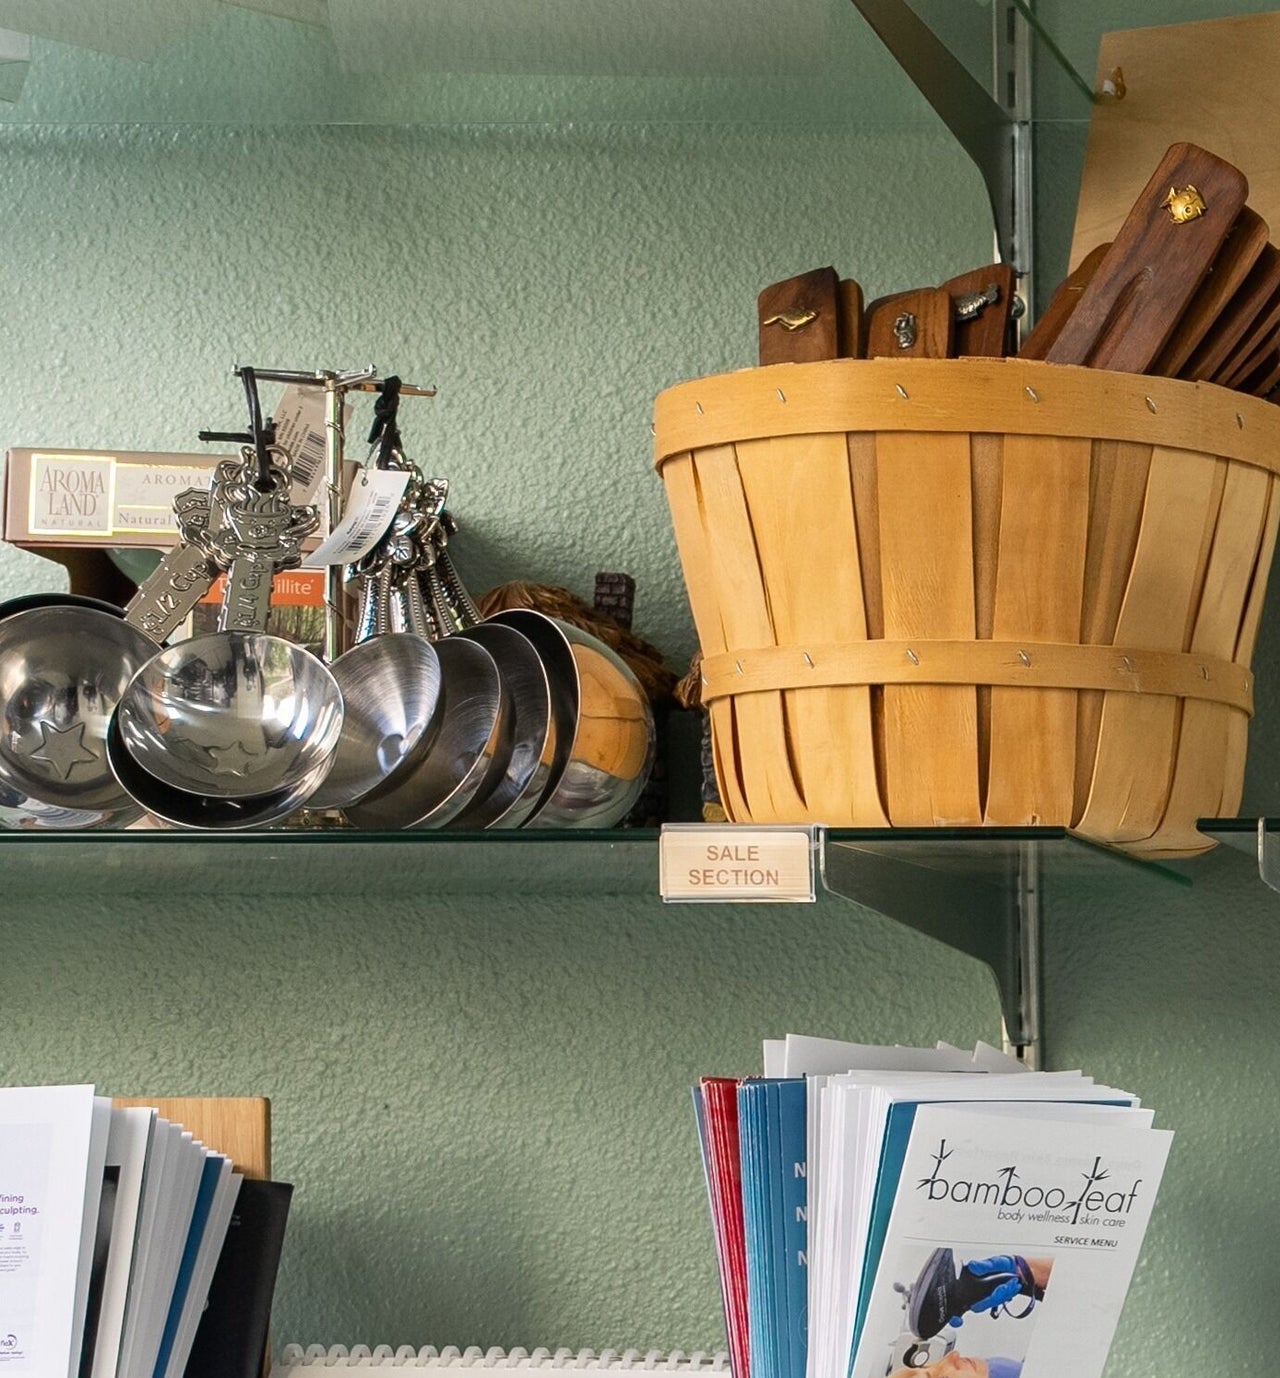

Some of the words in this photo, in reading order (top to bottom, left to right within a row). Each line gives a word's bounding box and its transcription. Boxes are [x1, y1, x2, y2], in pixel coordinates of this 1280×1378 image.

[40, 466, 104, 494] AROMA
[49, 493, 96, 517] LAND
[119, 513, 174, 526] Natural
[706, 845, 760, 862] SALE
[688, 868, 780, 886] SECTION
[917, 1139, 1066, 1208] bamboo
[1054, 1235, 1088, 1247] SERVICE
[1090, 1237, 1118, 1248] MENU
